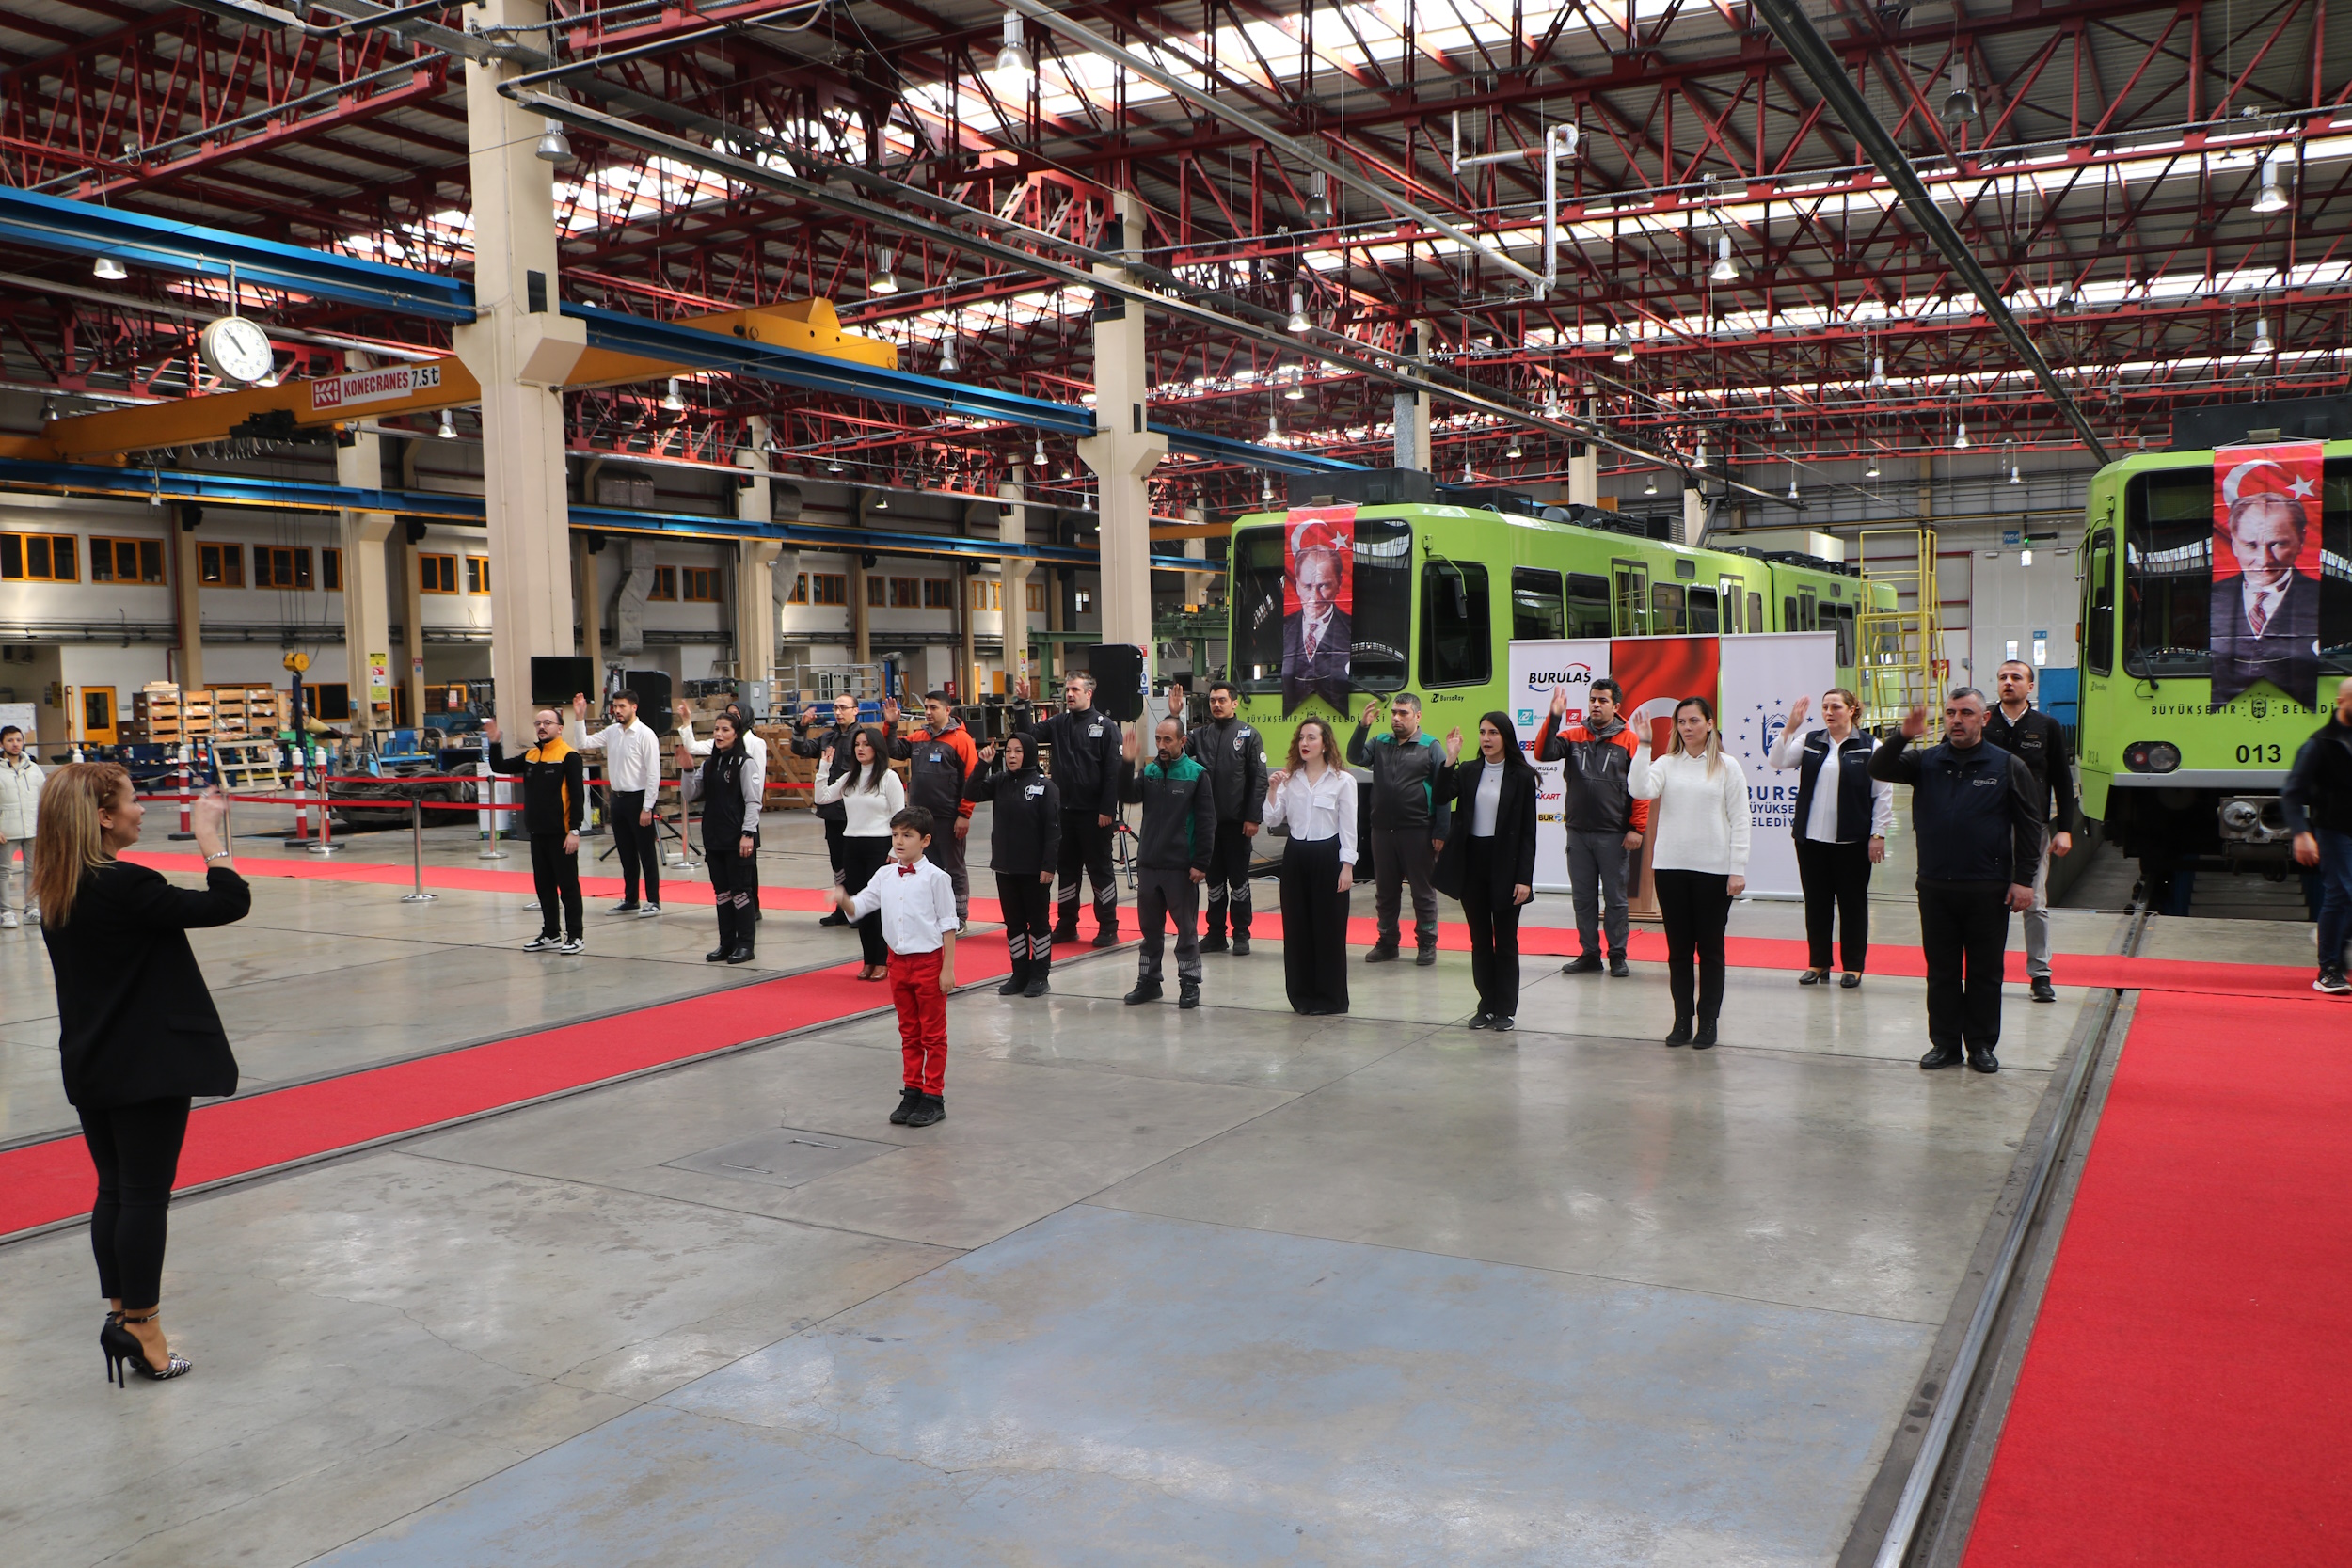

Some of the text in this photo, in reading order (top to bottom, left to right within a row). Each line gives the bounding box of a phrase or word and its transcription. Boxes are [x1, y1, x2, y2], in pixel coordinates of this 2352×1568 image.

[343, 371, 409, 398] KONECRANES
[412, 369, 429, 388] 7.5
[1529, 672, 1592, 686] BURULAŞ
[1439, 694, 1464, 703] BursaRay
[1326, 714, 1385, 723] BELDİSİ
[2235, 744, 2281, 764] 013
[1747, 786, 1799, 800] URS
[1751, 815, 1795, 827] ELEDİY
